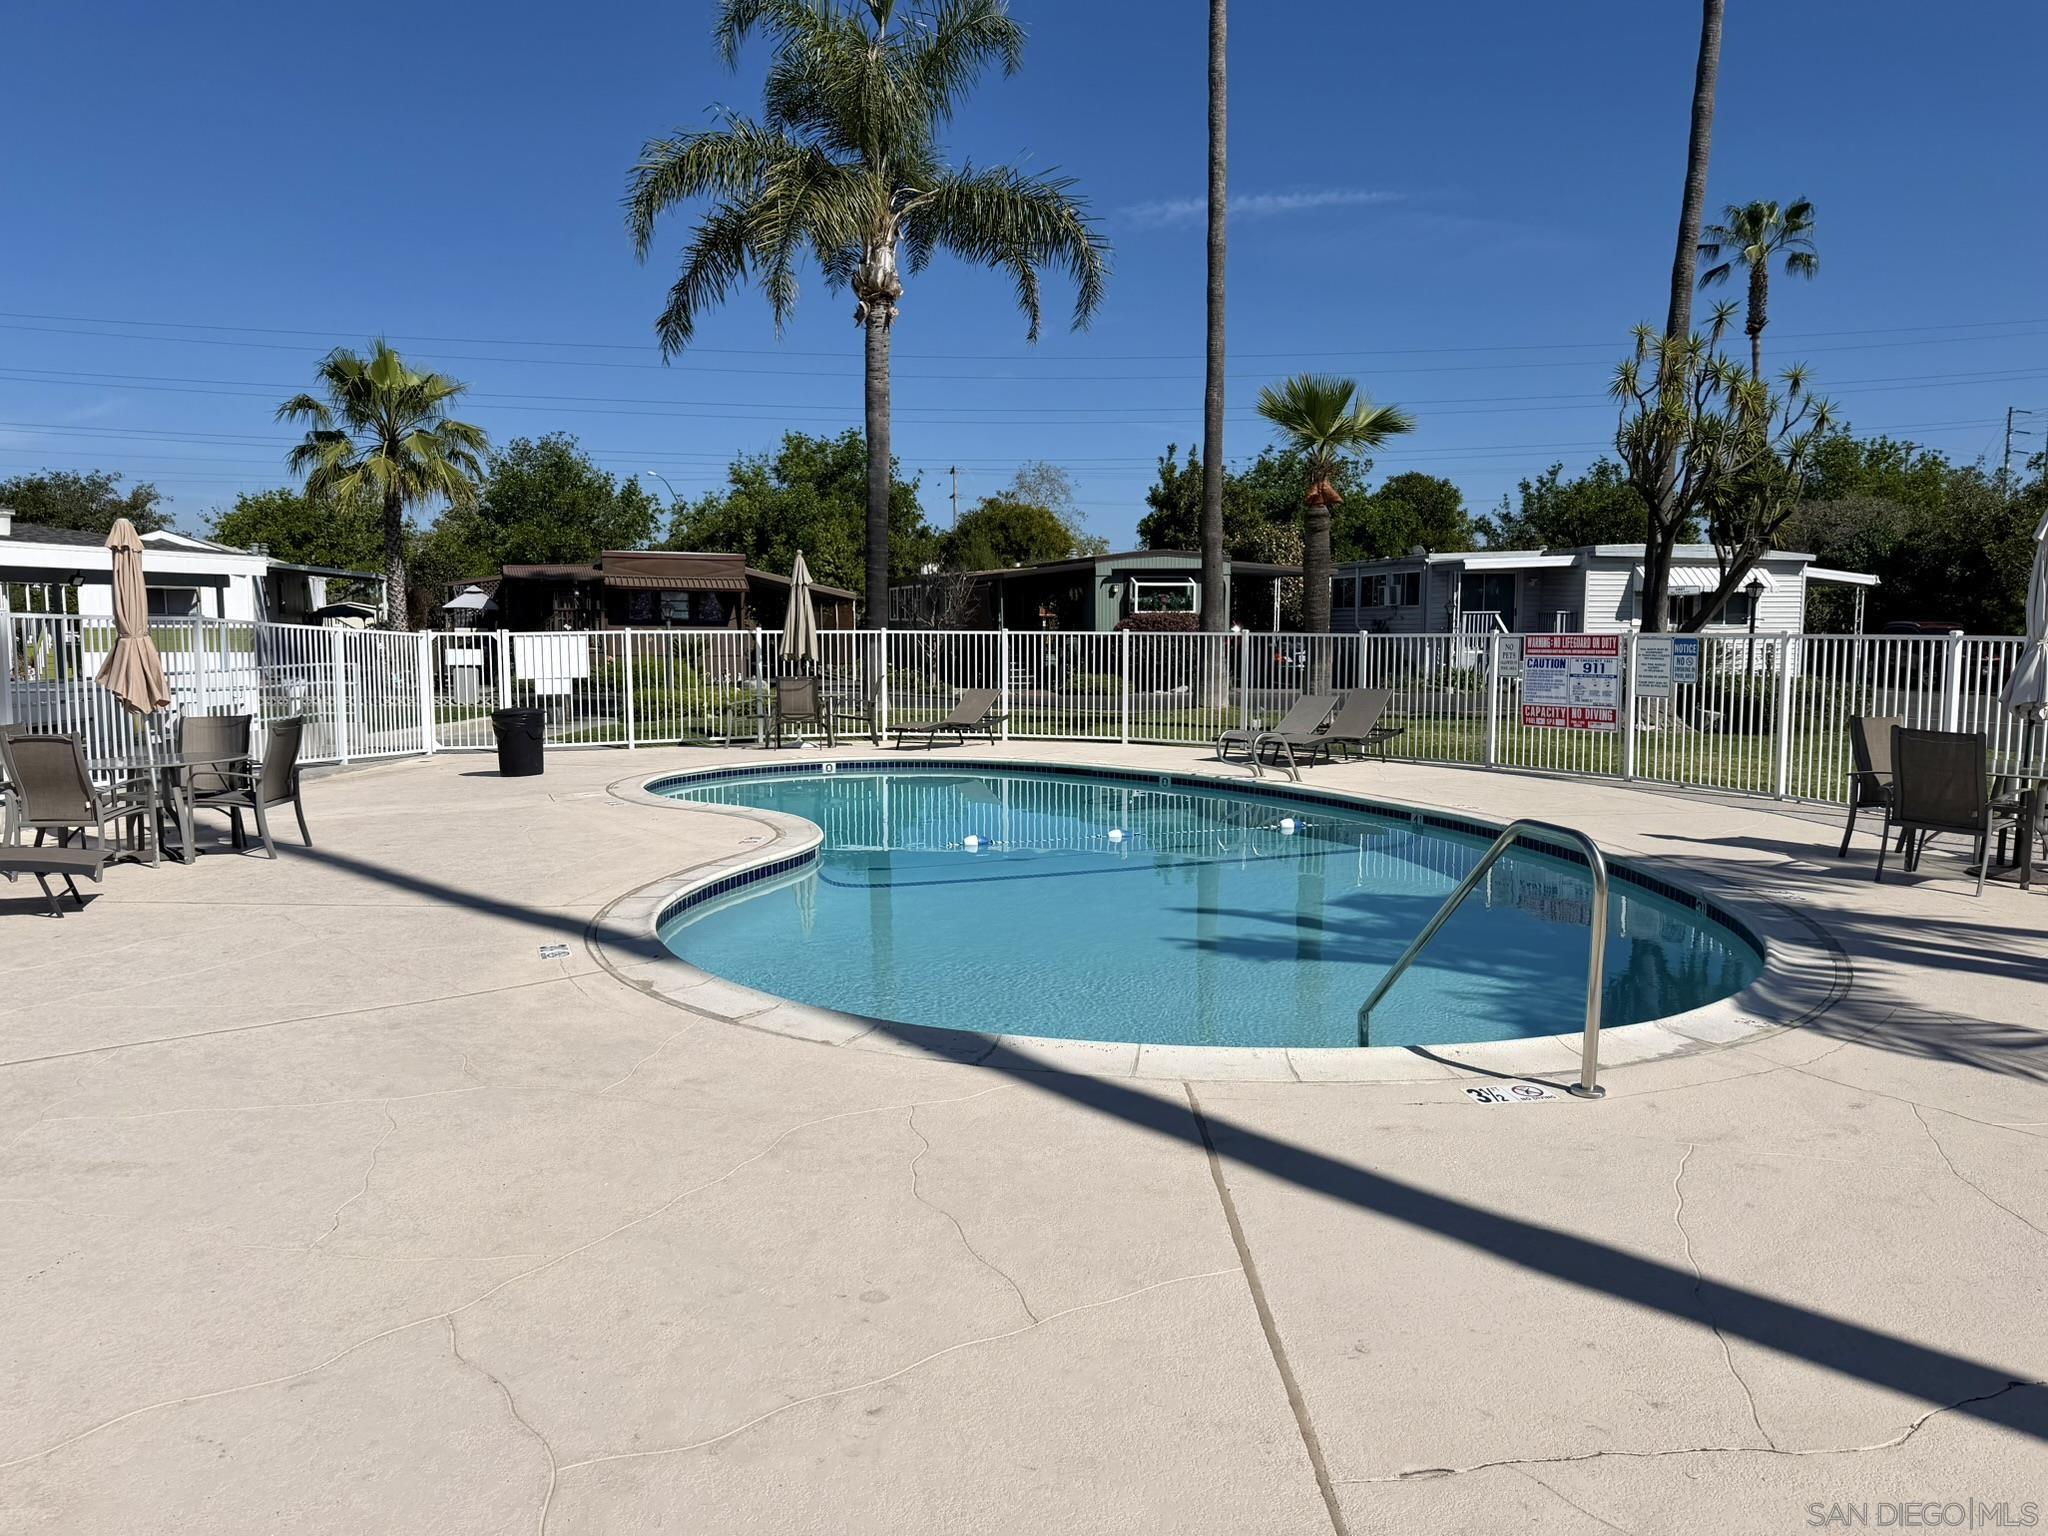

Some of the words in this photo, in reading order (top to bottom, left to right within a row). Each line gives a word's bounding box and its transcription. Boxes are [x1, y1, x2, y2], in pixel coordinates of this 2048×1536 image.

[1505, 643, 1514, 651] NO
[1554, 637, 1561, 648] NO
[1562, 637, 1591, 648] LIFEGUARD
[1592, 637, 1600, 648] ON
[1601, 637, 1617, 649] DUTY
[1675, 644, 1697, 653] NOTICE
[1527, 658, 1567, 669] CAUTION
[1676, 657, 1684, 665] NO
[1583, 662, 1605, 674] 911
[1524, 706, 1566, 718] CAPACITY
[1571, 708, 1582, 719] NO
[1585, 708, 1613, 721] DIVING
